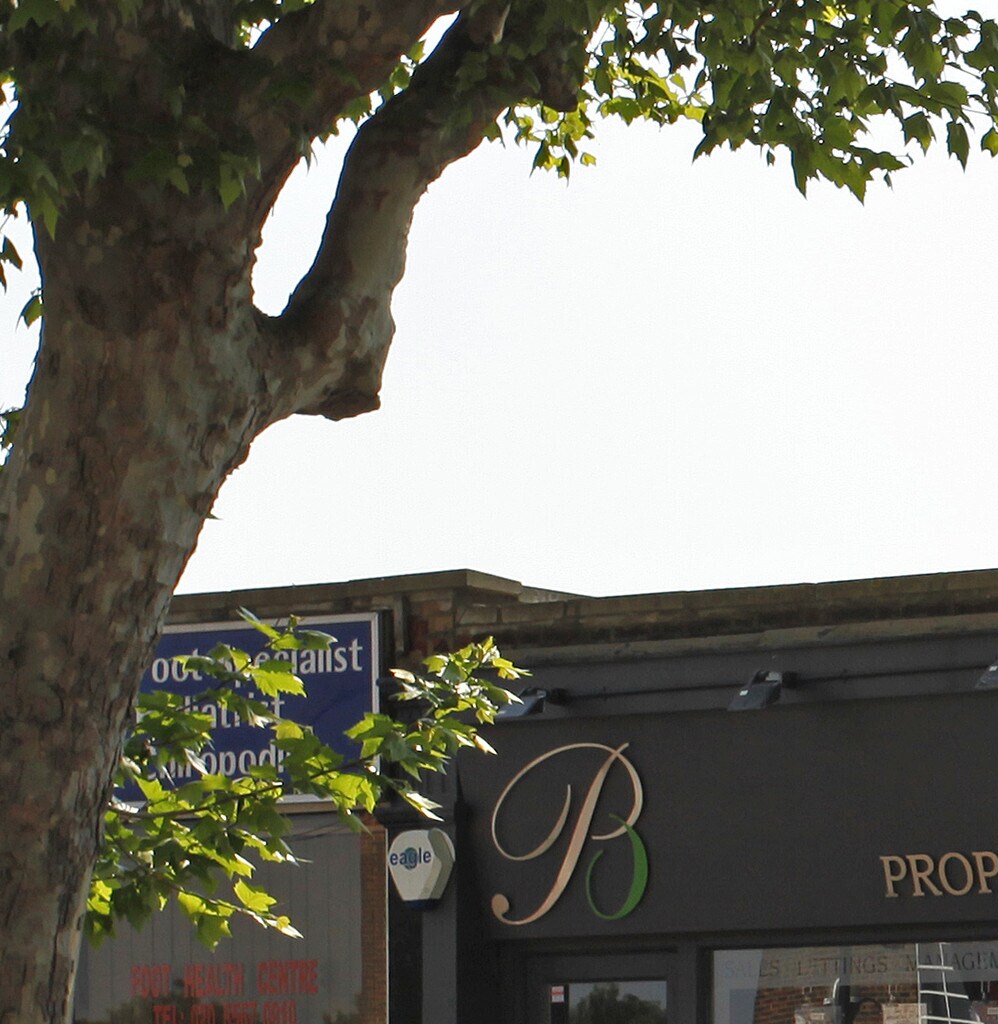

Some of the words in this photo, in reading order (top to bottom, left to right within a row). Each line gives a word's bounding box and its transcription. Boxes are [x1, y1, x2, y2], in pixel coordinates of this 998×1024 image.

[151, 648, 203, 683] oot
[390, 847, 431, 870] eagle
[182, 962, 245, 998] HEALTH
[256, 959, 319, 995] CENTRE
